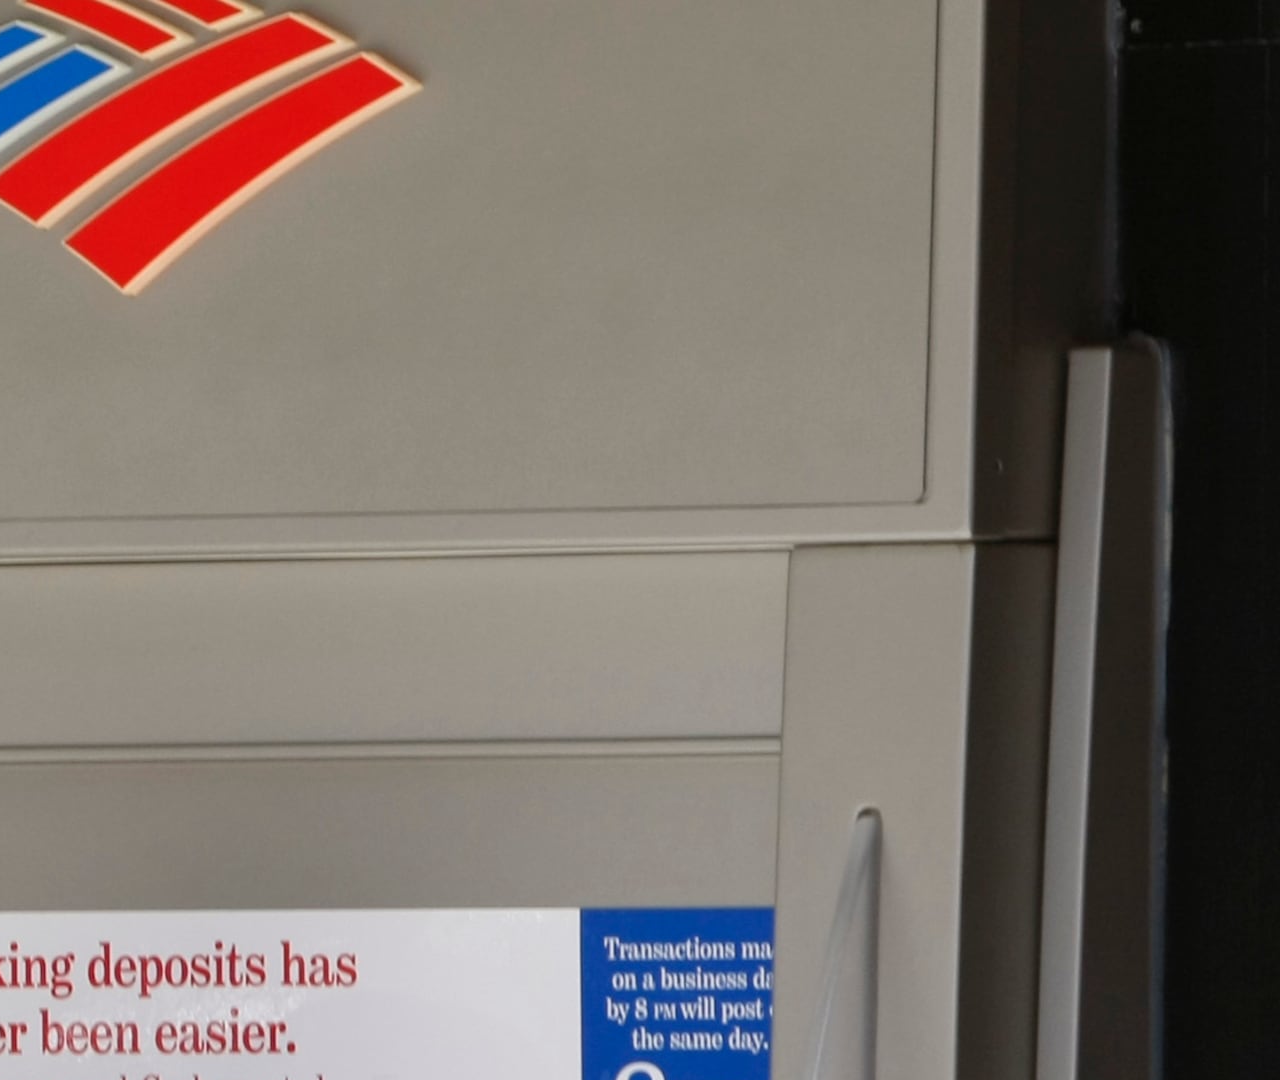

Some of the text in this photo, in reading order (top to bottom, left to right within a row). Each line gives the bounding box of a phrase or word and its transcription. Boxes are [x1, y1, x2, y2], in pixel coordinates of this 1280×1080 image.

[604, 936, 773, 961] Transactions ma
[88, 941, 266, 997] deposits
[281, 940, 357, 988] has
[612, 966, 773, 990] on a business da
[606, 997, 629, 1025] by
[635, 997, 648, 1020] 8
[654, 1003, 676, 1020] PM
[680, 996, 715, 1020] will
[722, 998, 763, 1025] post
[40, 1008, 140, 1055] been
[154, 1008, 296, 1055] easier.
[632, 1026, 768, 1055] the same day.
